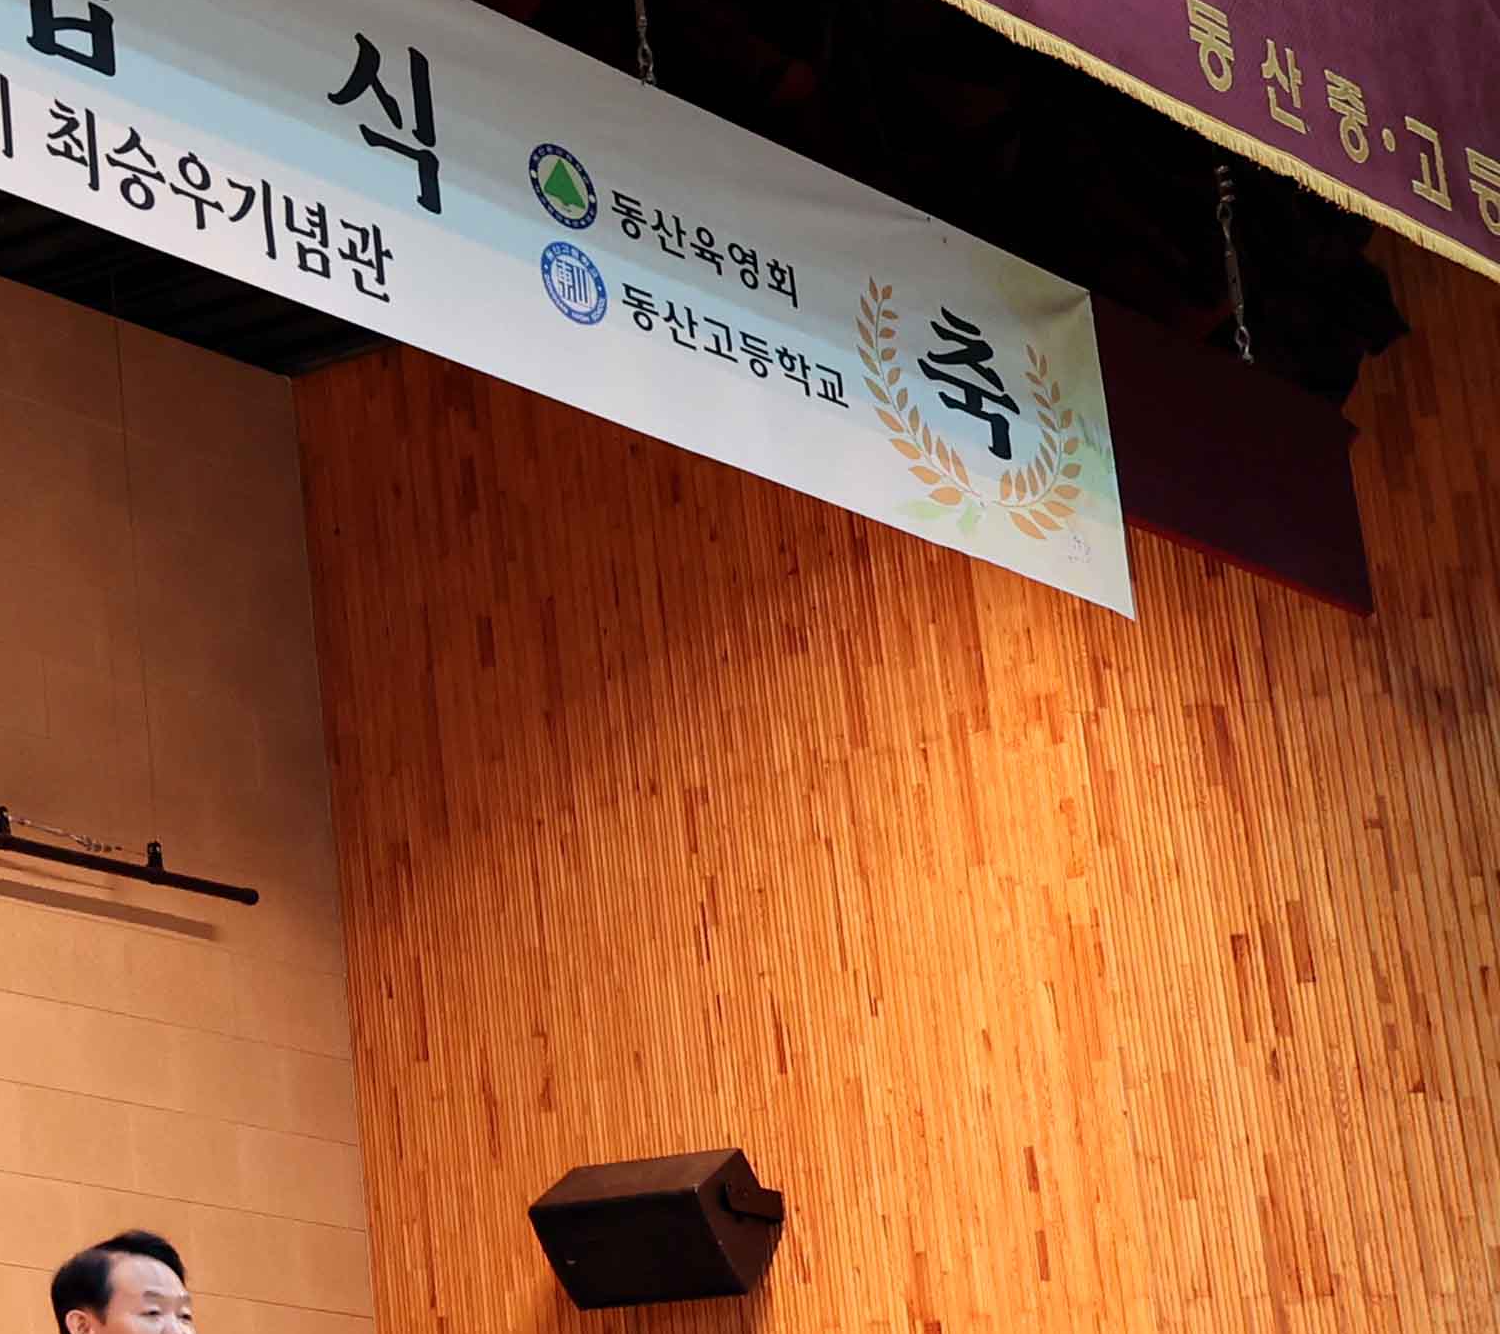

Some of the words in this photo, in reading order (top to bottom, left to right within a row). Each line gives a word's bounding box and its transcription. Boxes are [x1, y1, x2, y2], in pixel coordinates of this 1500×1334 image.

[47, 100, 393, 303] 최승우기념관
[611, 190, 799, 308] 동산육영회
[622, 283, 849, 408] 동산고등학교
[917, 306, 1020, 460] 축
